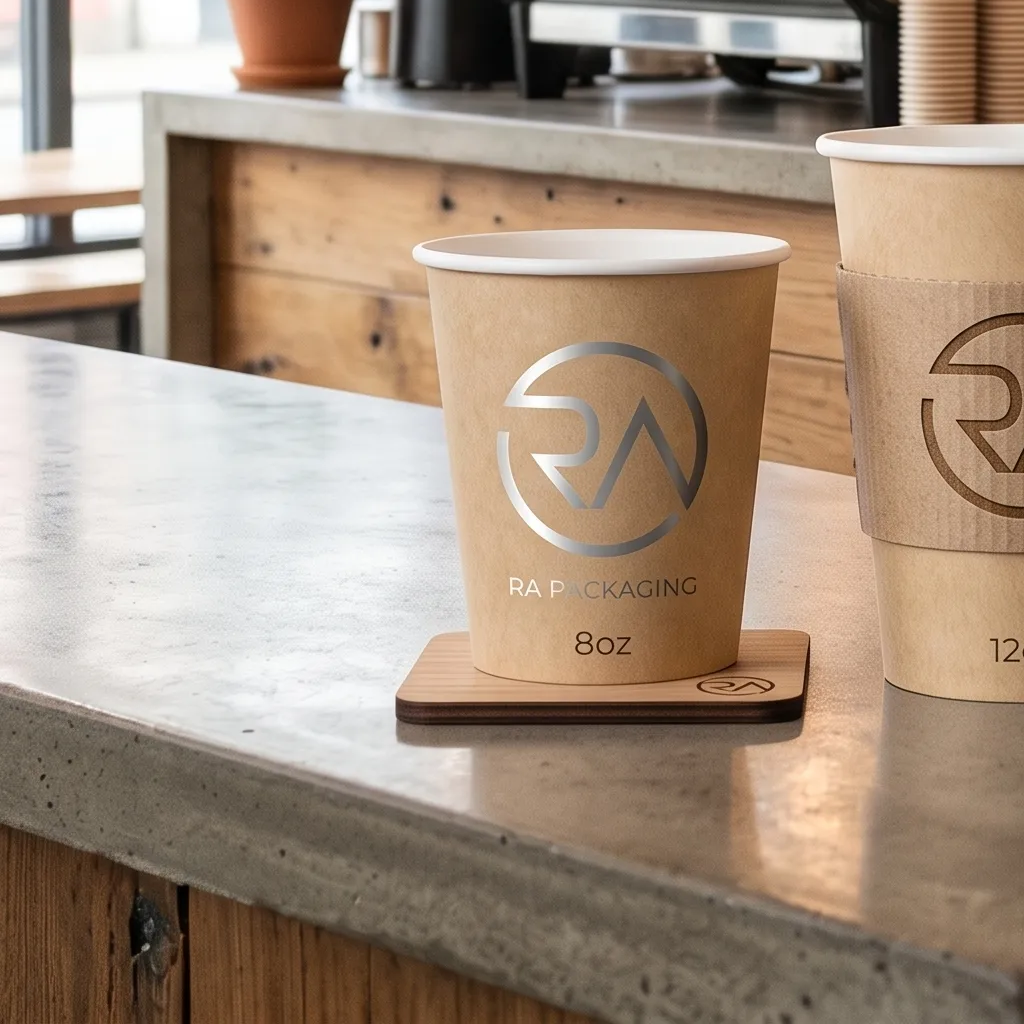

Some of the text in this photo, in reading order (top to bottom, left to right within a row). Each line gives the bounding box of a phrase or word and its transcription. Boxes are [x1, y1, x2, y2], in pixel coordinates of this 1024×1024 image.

[509, 576, 697, 600] RA PACKAGING
[574, 631, 632, 655] 8oz
